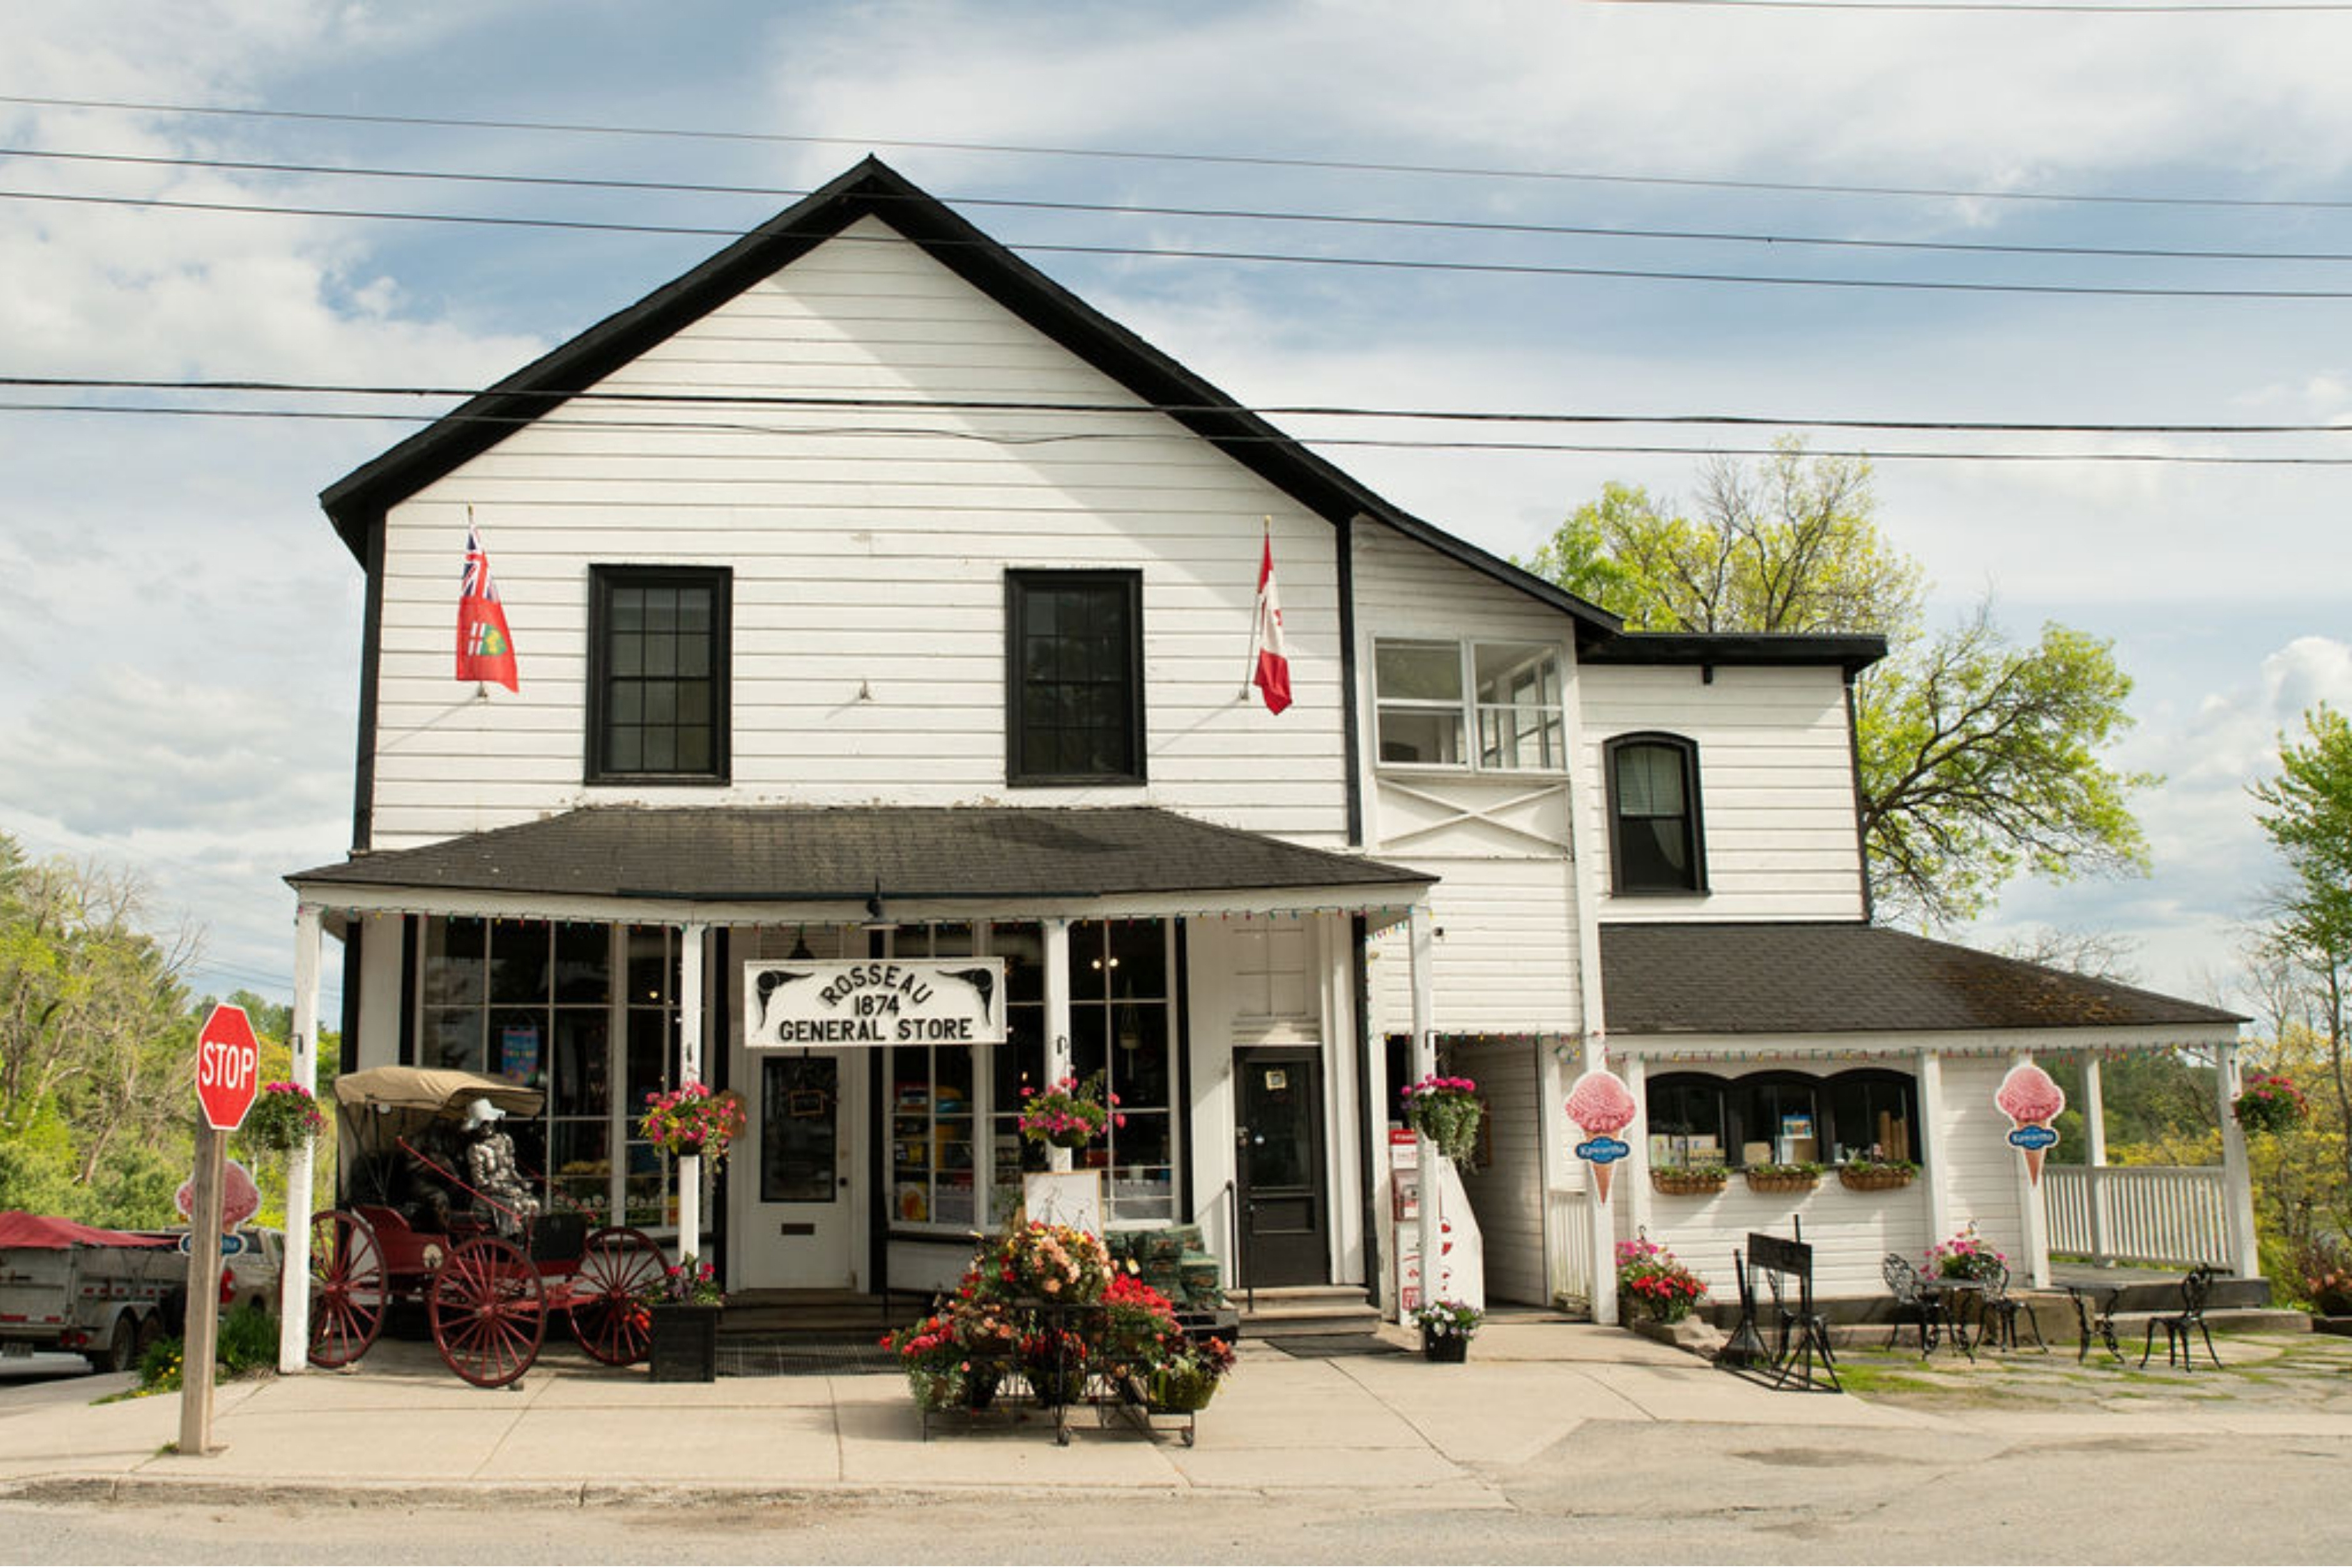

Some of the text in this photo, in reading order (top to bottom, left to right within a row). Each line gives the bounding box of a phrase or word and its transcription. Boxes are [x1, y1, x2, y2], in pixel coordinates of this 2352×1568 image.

[820, 962, 934, 1006] ROSSEAU
[854, 995, 900, 1016] 1874
[779, 1018, 973, 1042] GENERAL STORE
[201, 1041, 255, 1090] STOP
